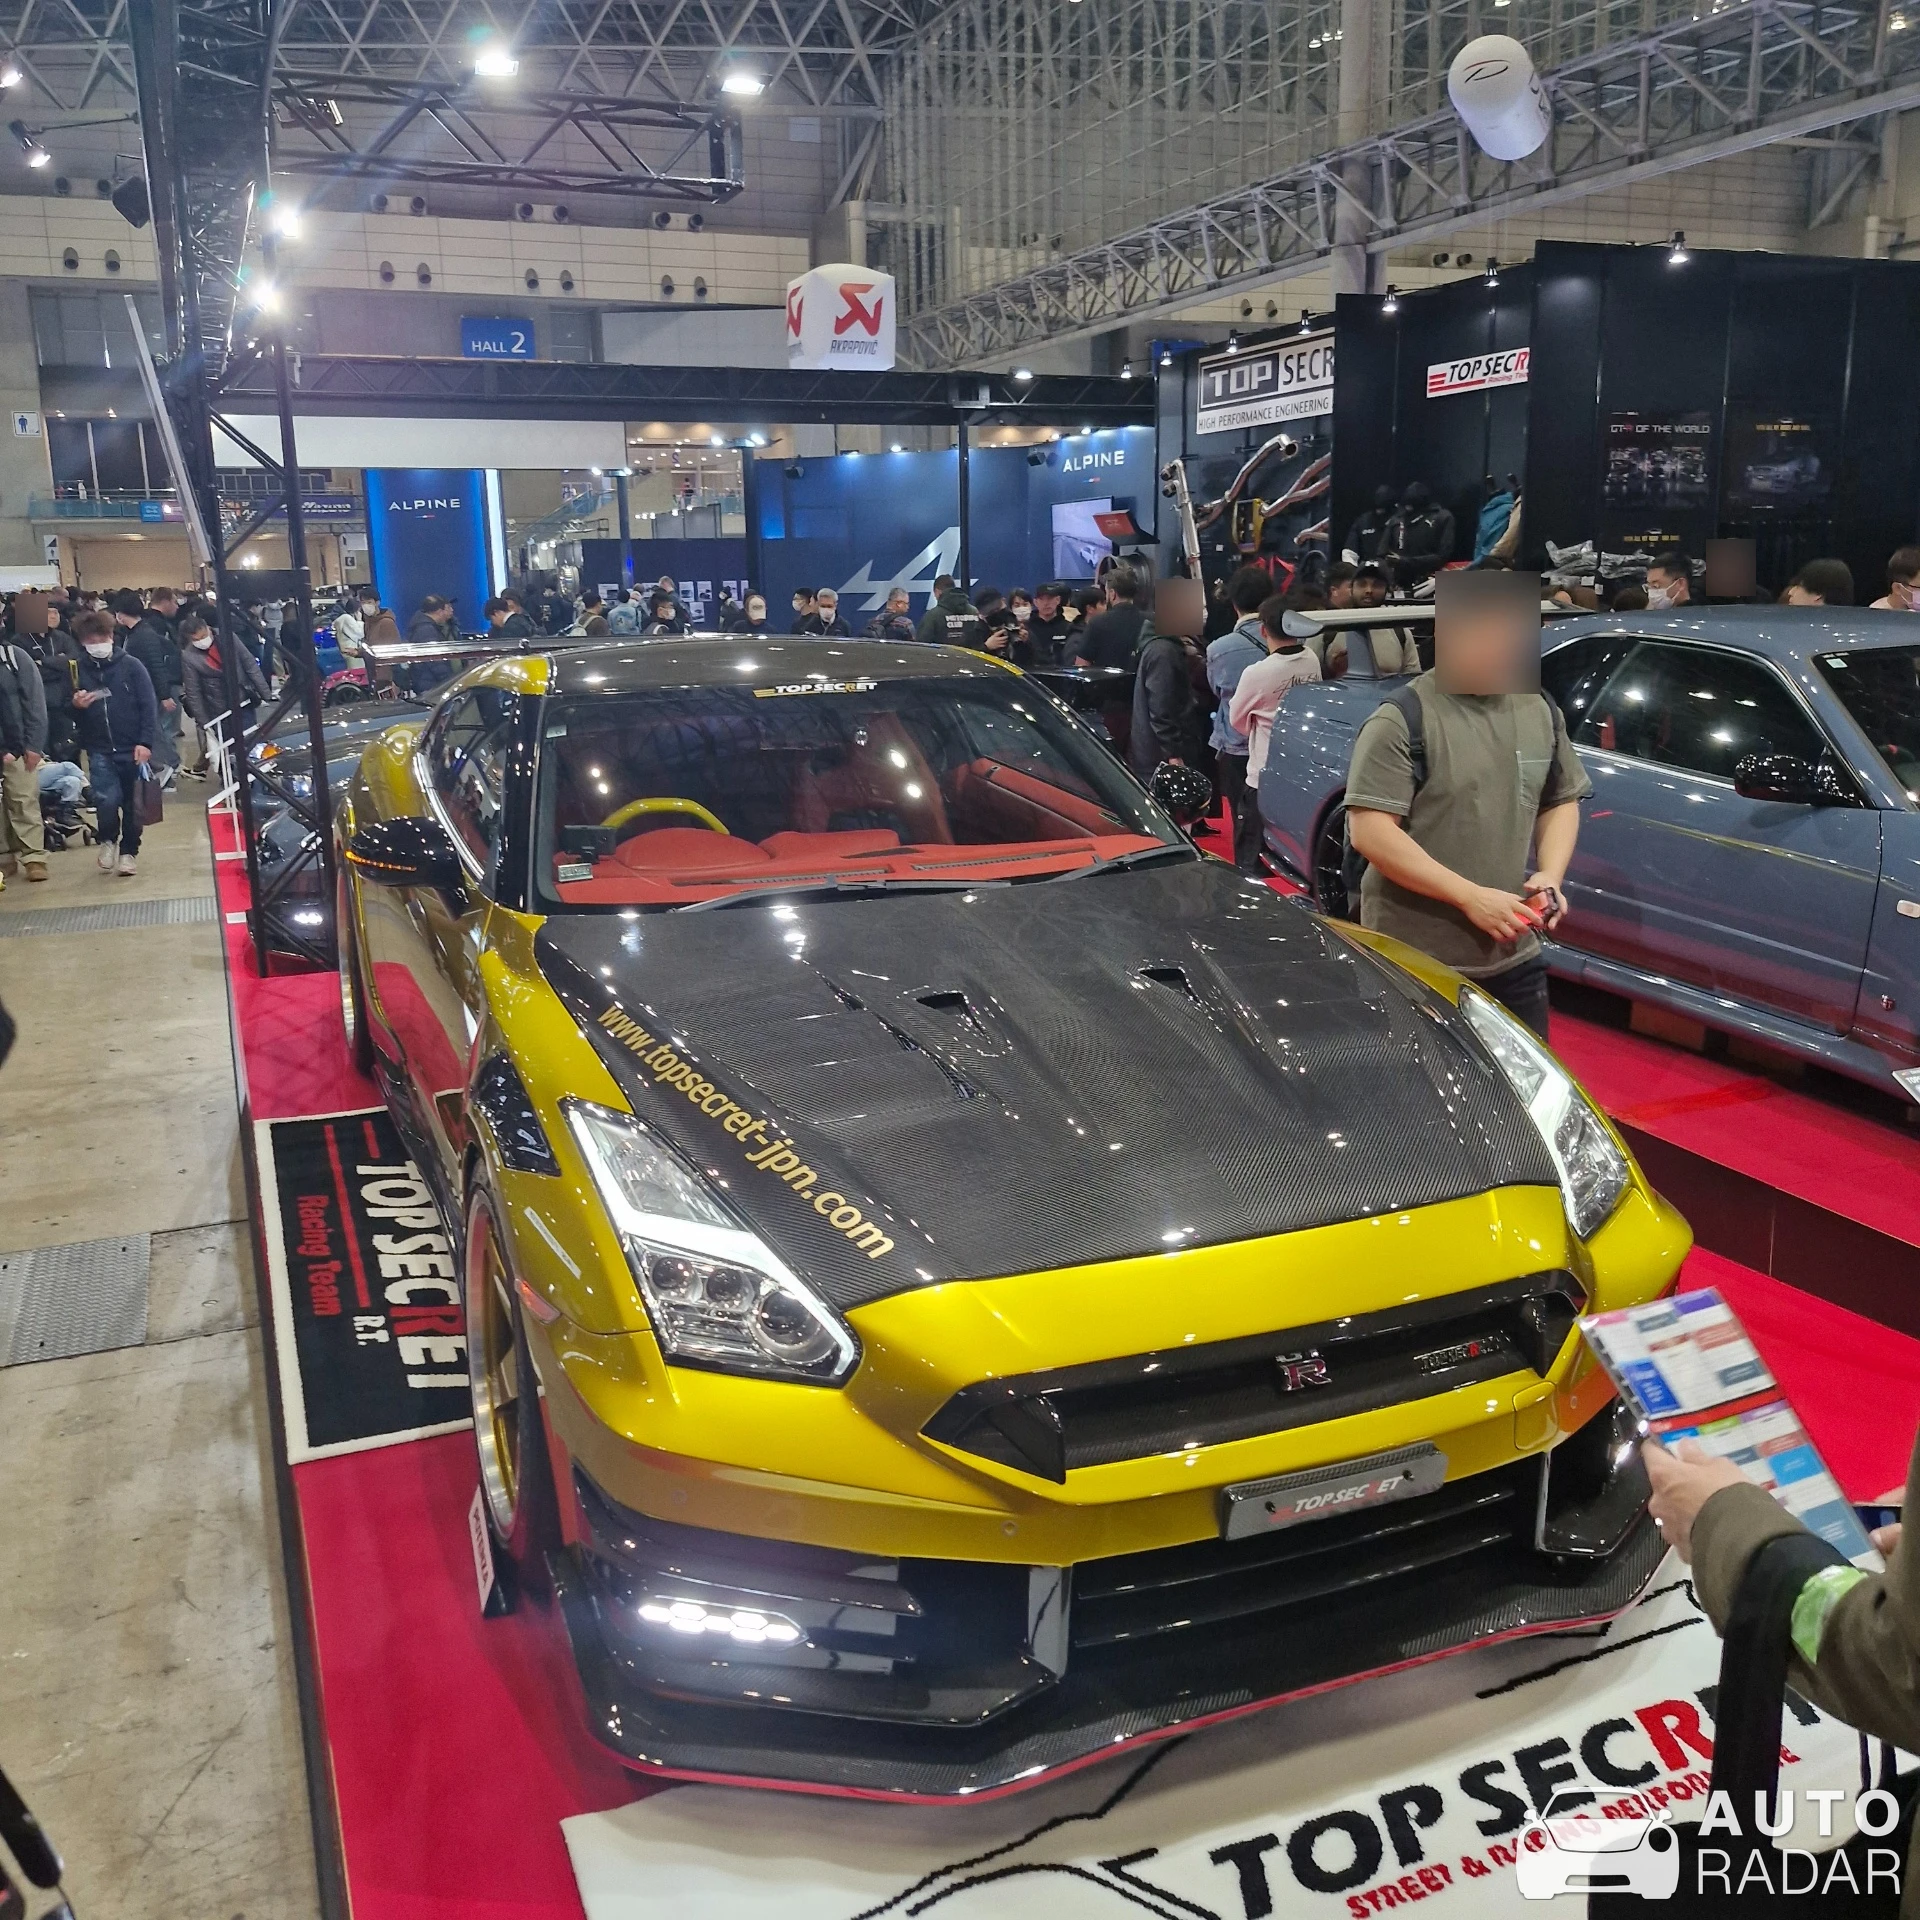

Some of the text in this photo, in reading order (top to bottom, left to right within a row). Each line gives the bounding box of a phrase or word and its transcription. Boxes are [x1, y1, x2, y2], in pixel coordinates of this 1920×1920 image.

[471, 331, 527, 354] HALL 2
[830, 339, 878, 355] AKRAPOVIČ
[1208, 360, 1272, 397] TOP
[1199, 396, 1329, 430] HIGH PERFORMANCE ENGINEERING
[1635, 424, 1650, 433] OF
[1652, 425, 1672, 433] THE
[1674, 425, 1710, 433] WORLD
[1062, 449, 1125, 473] ALPINE
[388, 498, 461, 511] ALPINE
[597, 1005, 896, 1260] www.topsecret-jpn.com
[297, 1195, 343, 1316] Racing Team
[1208, 1680, 1821, 1919] TOP SECR
[1346, 1863, 1454, 1919] STREET
[1460, 1855, 1492, 1878] &
